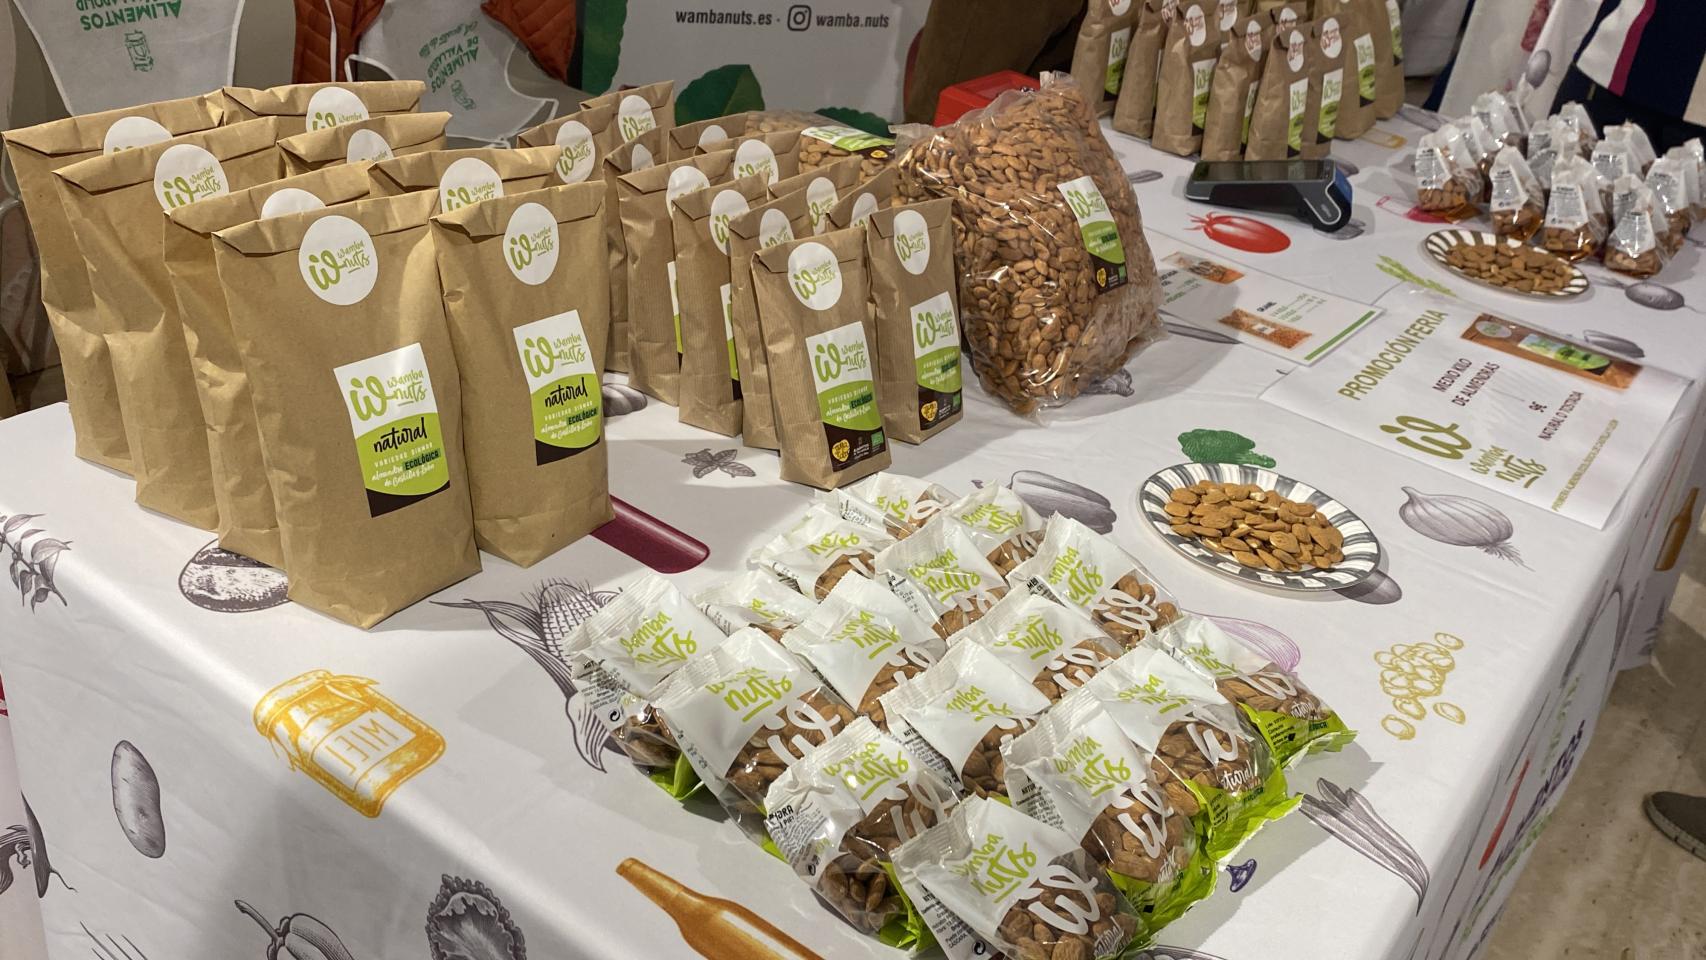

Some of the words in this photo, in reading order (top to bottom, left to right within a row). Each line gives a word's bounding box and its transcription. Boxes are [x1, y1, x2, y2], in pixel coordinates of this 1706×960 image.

[80, 0, 182, 31] ALIMENTOS
[675, 9, 773, 26] wambanuts.es
[816, 13, 890, 28] wamba.nuts
[431, 48, 479, 93] ALIMENTOS
[337, 240, 366, 258] wamba
[344, 250, 370, 269] nuts
[554, 333, 582, 349] wamba
[559, 344, 586, 363] nuts
[1338, 334, 1417, 400] PROMOCIÓN
[1404, 309, 1449, 342] FERIA
[387, 369, 424, 388] wamba
[1432, 369, 1461, 392] MEDIO
[1452, 358, 1472, 376] KILO
[1460, 362, 1501, 398] ALMENDRAS
[394, 381, 427, 404] nuts
[545, 377, 588, 408] natural
[1451, 395, 1470, 407] DE
[1537, 417, 1562, 441] NATURAL
[1560, 390, 1584, 414] TOSTADA
[374, 417, 427, 453] natural
[404, 450, 440, 471] ECOLÓGICA
[1469, 444, 1508, 475] wamba
[1494, 454, 1548, 483] nuts
[924, 565, 981, 593] nuts
[635, 627, 697, 665] nuts
[724, 674, 793, 712] nuts
[1069, 753, 1132, 790] nuts
[970, 842, 1037, 896] nuts
